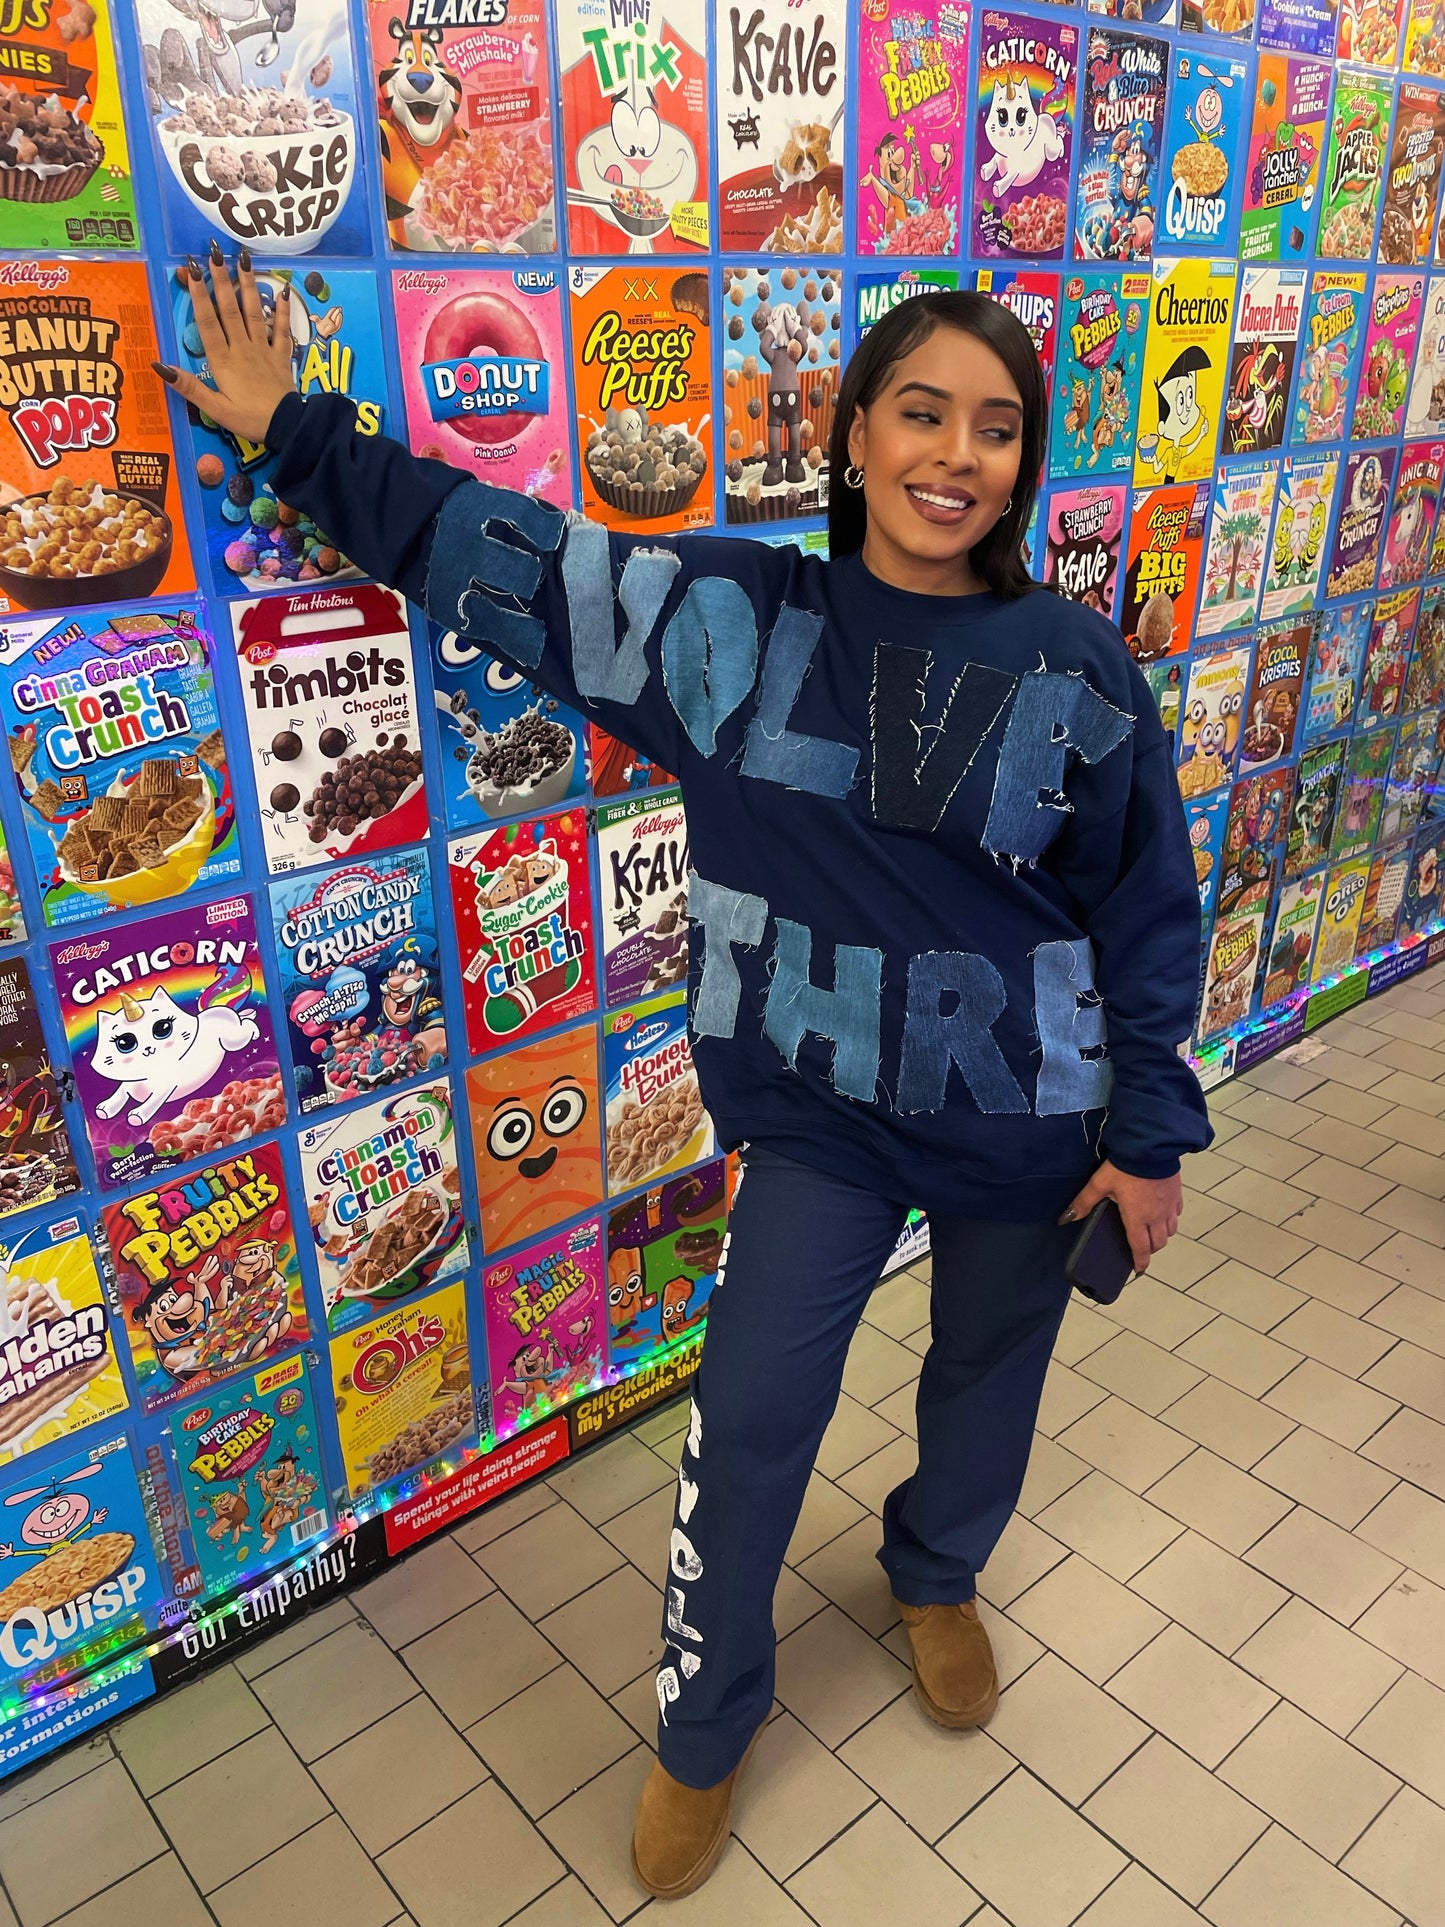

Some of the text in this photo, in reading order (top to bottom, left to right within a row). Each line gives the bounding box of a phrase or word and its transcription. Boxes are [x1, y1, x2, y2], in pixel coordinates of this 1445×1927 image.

[409, 0, 506, 25] FLAKES
[446, 31, 520, 64] Strawberry
[459, 48, 514, 74] Milkshake
[583, 23, 682, 90] Trix
[986, 39, 1071, 81] CATICORN
[1122, 48, 1161, 75] White
[478, 91, 529, 105] Makes delicious
[880, 62, 951, 120] PEBBLES
[1405, 85, 1419, 99] WIN
[476, 98, 531, 114] STRAWBERRY
[483, 109, 526, 123] flavored milk!
[1094, 96, 1155, 132] CRUNCH
[1344, 130, 1373, 149] APPLE
[1407, 130, 1435, 147] FROSTED
[1407, 142, 1429, 158] FLAKES
[1264, 148, 1298, 177] JOLLY
[1330, 145, 1378, 202] JACKS
[1264, 170, 1298, 190] rancher
[728, 187, 774, 202] CHOCOLATE
[1266, 189, 1293, 204] CEREAL
[1242, 242, 1272, 259] CRUNCH!
[1245, 231, 1270, 247] FRUITY
[1, 263, 68, 288] Kellogg's
[398, 272, 447, 295] Kellogg's
[518, 272, 554, 288] NEW!
[0, 300, 88, 316] CHOCOLATE
[1081, 293, 1112, 313] BIRTHDAY
[1088, 306, 1104, 321] CAKE
[1156, 284, 1229, 327] Cheerios
[1240, 293, 1298, 332] Cocoa Puffs
[0, 317, 114, 357] EANUT
[584, 311, 695, 364] Reese's
[1070, 310, 1121, 361] PEBBLES
[1311, 305, 1354, 349] PEBBLES
[301, 340, 351, 394] All
[434, 362, 540, 398] DONUT
[0, 359, 118, 406] BUTTER
[600, 362, 688, 410] Puffs
[462, 392, 520, 410] SHOP
[16, 397, 112, 463] POPS
[135, 456, 159, 466] REAL
[474, 445, 516, 459] Pink Donut
[118, 465, 163, 475] PEANUT
[119, 474, 163, 485] BUTTER
[1065, 497, 1112, 528] STRAWBERRY
[1147, 504, 1189, 531] Reese's
[1073, 516, 1104, 540] CRUNCH
[1149, 527, 1180, 552] Puffs
[1339, 518, 1378, 551] CRUNCH
[1137, 552, 1186, 581] BIG
[1134, 576, 1185, 603] PUFFS
[287, 595, 354, 613] Tim Hortons
[32, 623, 86, 665] NEW!
[250, 645, 272, 660] Post
[1267, 646, 1298, 667] COCOA
[17, 644, 185, 708] Cinna GRAHAM
[250, 648, 406, 709] timbits
[427, 480, 1136, 872] EVOLVE
[1259, 659, 1301, 689] KRISPIES
[59, 676, 157, 728] Toast
[343, 693, 408, 714] Chocolat
[50, 695, 188, 765] Crunch
[371, 706, 410, 728] glacé
[644, 796, 678, 811] WHOLE GRAIN
[633, 812, 684, 840] Kellogg's
[611, 840, 688, 910] KrAV
[208, 899, 244, 914] LIMITED
[482, 880, 568, 933] Sugar Cookie
[1326, 877, 1366, 912] OREO
[208, 907, 247, 923] EDITION!
[281, 875, 421, 948] COTTON CANDY
[1229, 904, 1258, 921] NEW!
[58, 941, 110, 963] Kellogg's
[296, 902, 414, 975] CRUNCH
[496, 914, 565, 963] Toast
[616, 940, 645, 959] DOUBLE
[1215, 928, 1257, 973] PEBBLES
[466, 954, 483, 975] Limited
[472, 959, 488, 980] Edition
[487, 928, 583, 996] Crunch
[611, 947, 652, 969] CHOCOLATE
[71, 941, 247, 1004] CATICORN
[3, 991, 26, 1005] OTHER
[614, 1014, 632, 1031] Post
[630, 1022, 666, 1047] Hostess
[622, 1037, 692, 1090] Honey
[639, 1062, 685, 1105] Bun
[319, 1110, 433, 1183] Cinnamon
[112, 1153, 135, 1171] Berry
[346, 1137, 417, 1192] Toast
[337, 1150, 442, 1223] Crunch
[120, 1174, 280, 1285] PEBBLES
[489, 1267, 509, 1284] Post
[508, 1268, 586, 1337] PEBBLES
[376, 1311, 404, 1334] Honey
[388, 1308, 421, 1335] Graham
[352, 1315, 446, 1394] Oh's
[260, 1363, 299, 1392] 2 BAGS
[272, 1371, 299, 1388] INSIDE!
[577, 1369, 655, 1420] CHICKEN
[578, 1413, 602, 1436] My
[606, 1405, 615, 1420] 3
[619, 1377, 675, 1412] favorite
[185, 1411, 207, 1429] Post
[199, 1408, 250, 1446] BIRTHDAY
[216, 1423, 243, 1445] CAKE
[189, 1413, 275, 1483] PEBBLES
[394, 1497, 434, 1527] Spend
[435, 1482, 461, 1507] your
[463, 1470, 480, 1487] life
[482, 1452, 513, 1477] doing
[515, 1430, 557, 1460] strange
[412, 1448, 547, 1530] things with weird people
